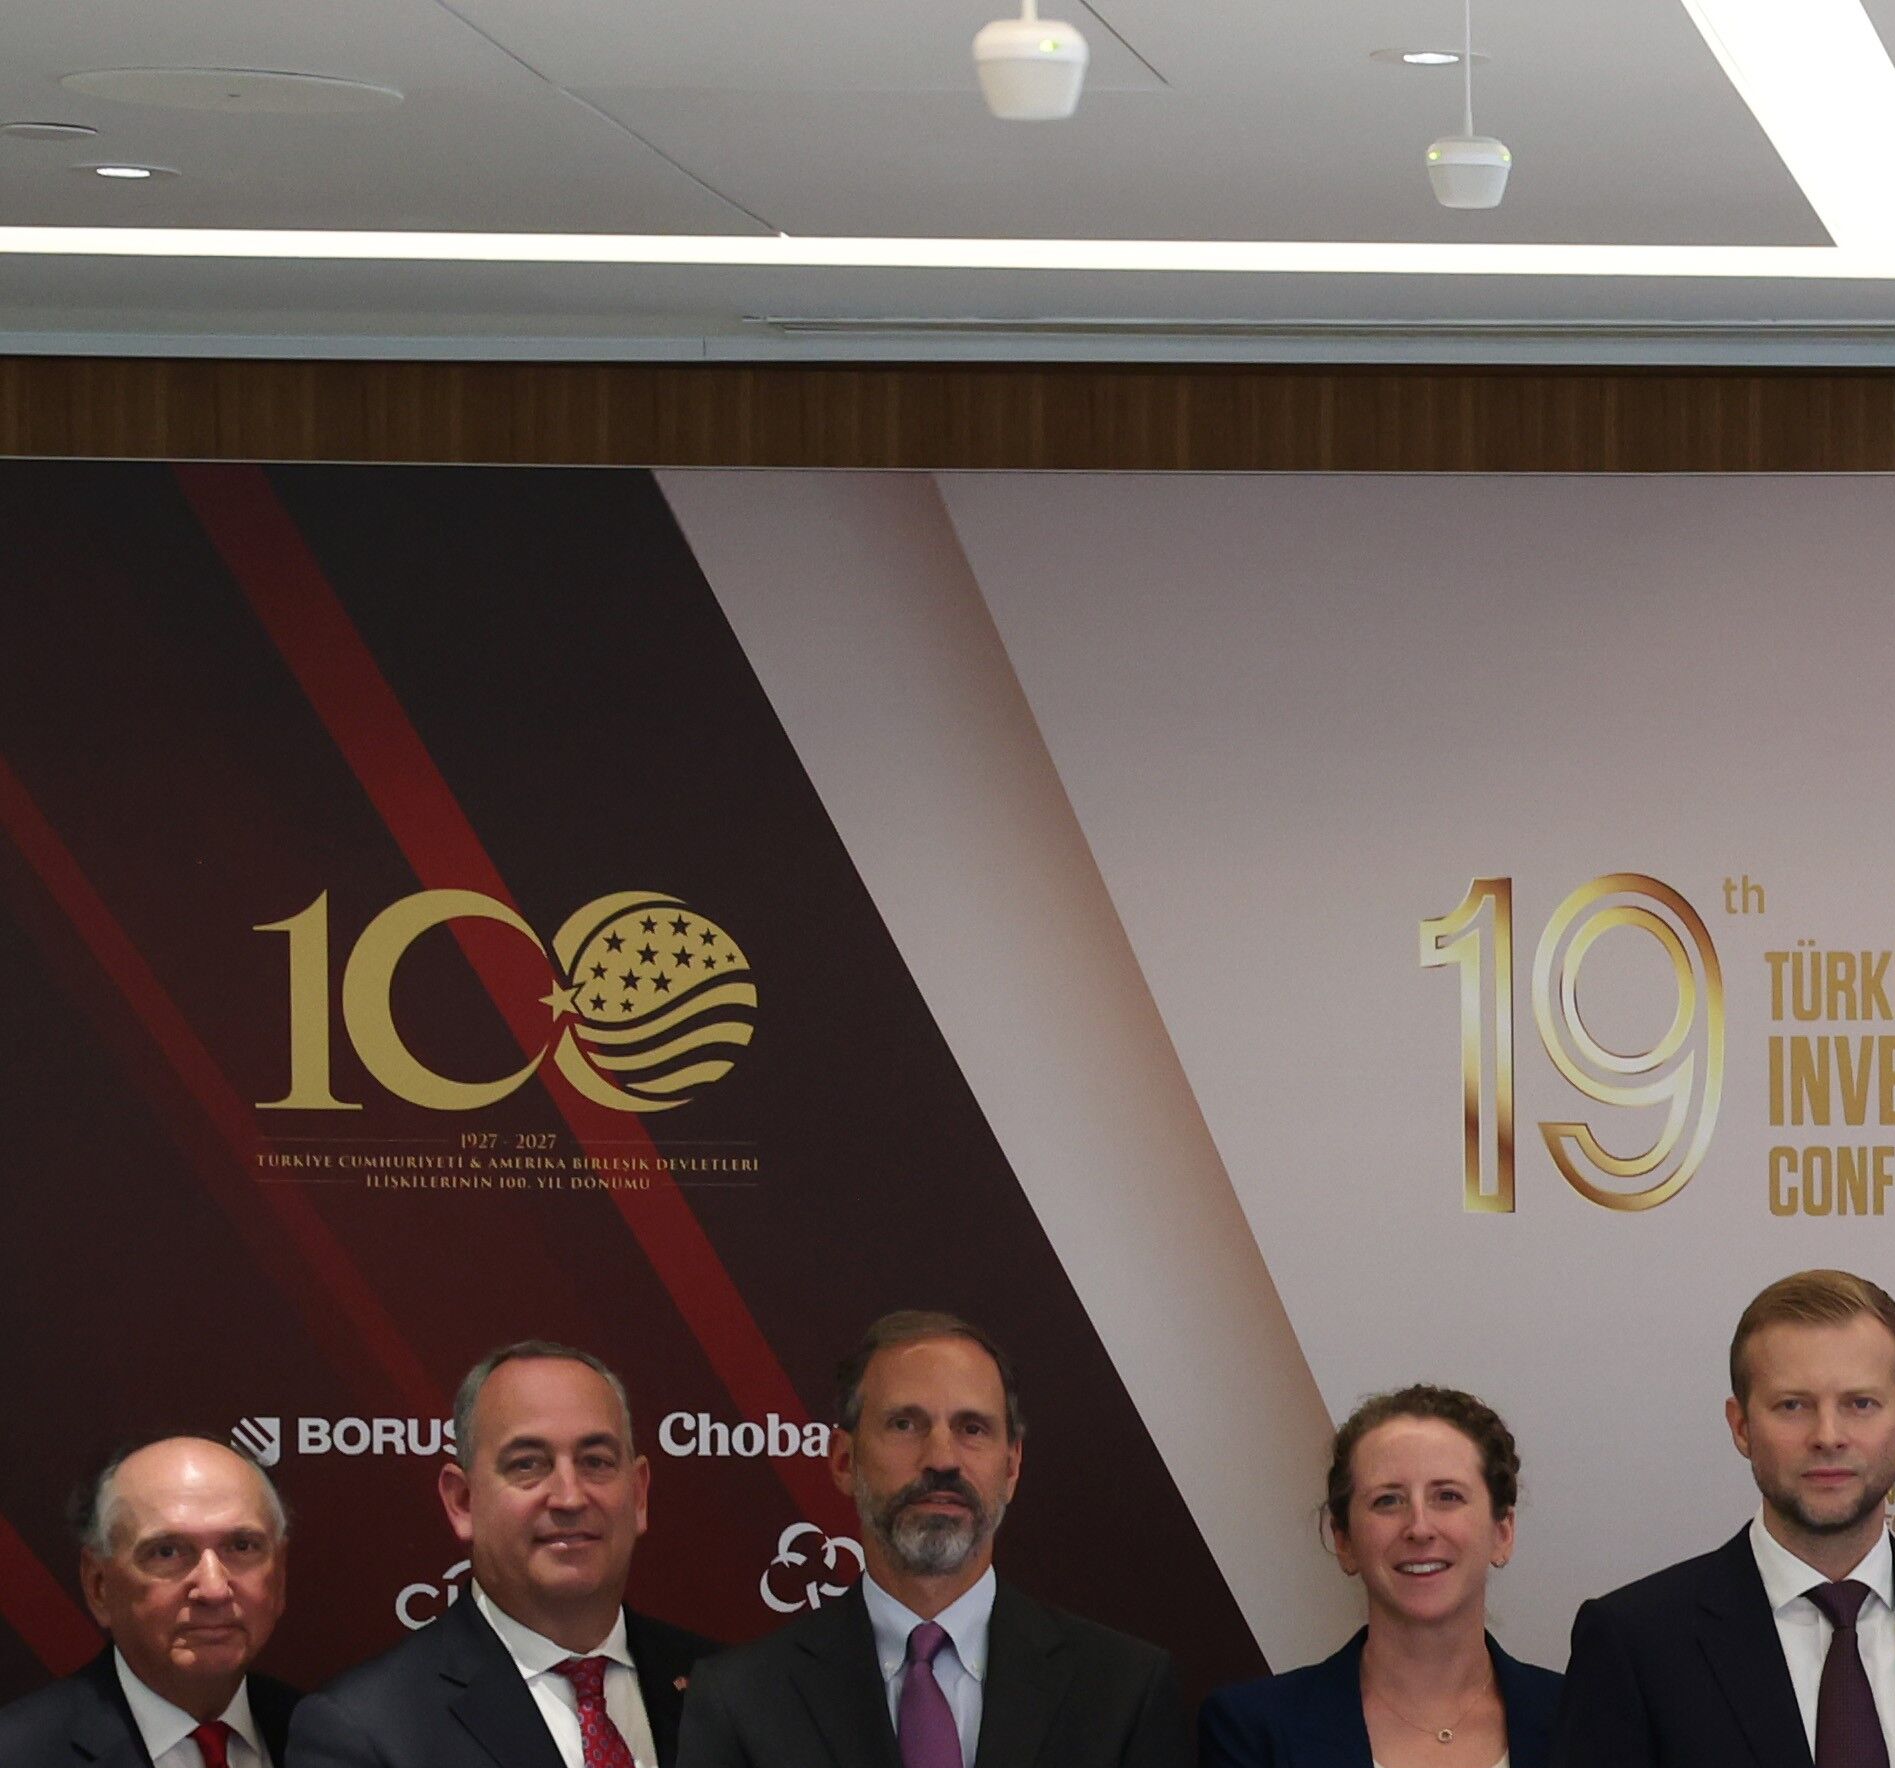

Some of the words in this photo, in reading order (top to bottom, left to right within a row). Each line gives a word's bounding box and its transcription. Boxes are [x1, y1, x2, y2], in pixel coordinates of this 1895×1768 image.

[461, 1133, 497, 1149] 1927
[515, 1133, 557, 1149] 2027
[658, 1411, 838, 1458] Choba
